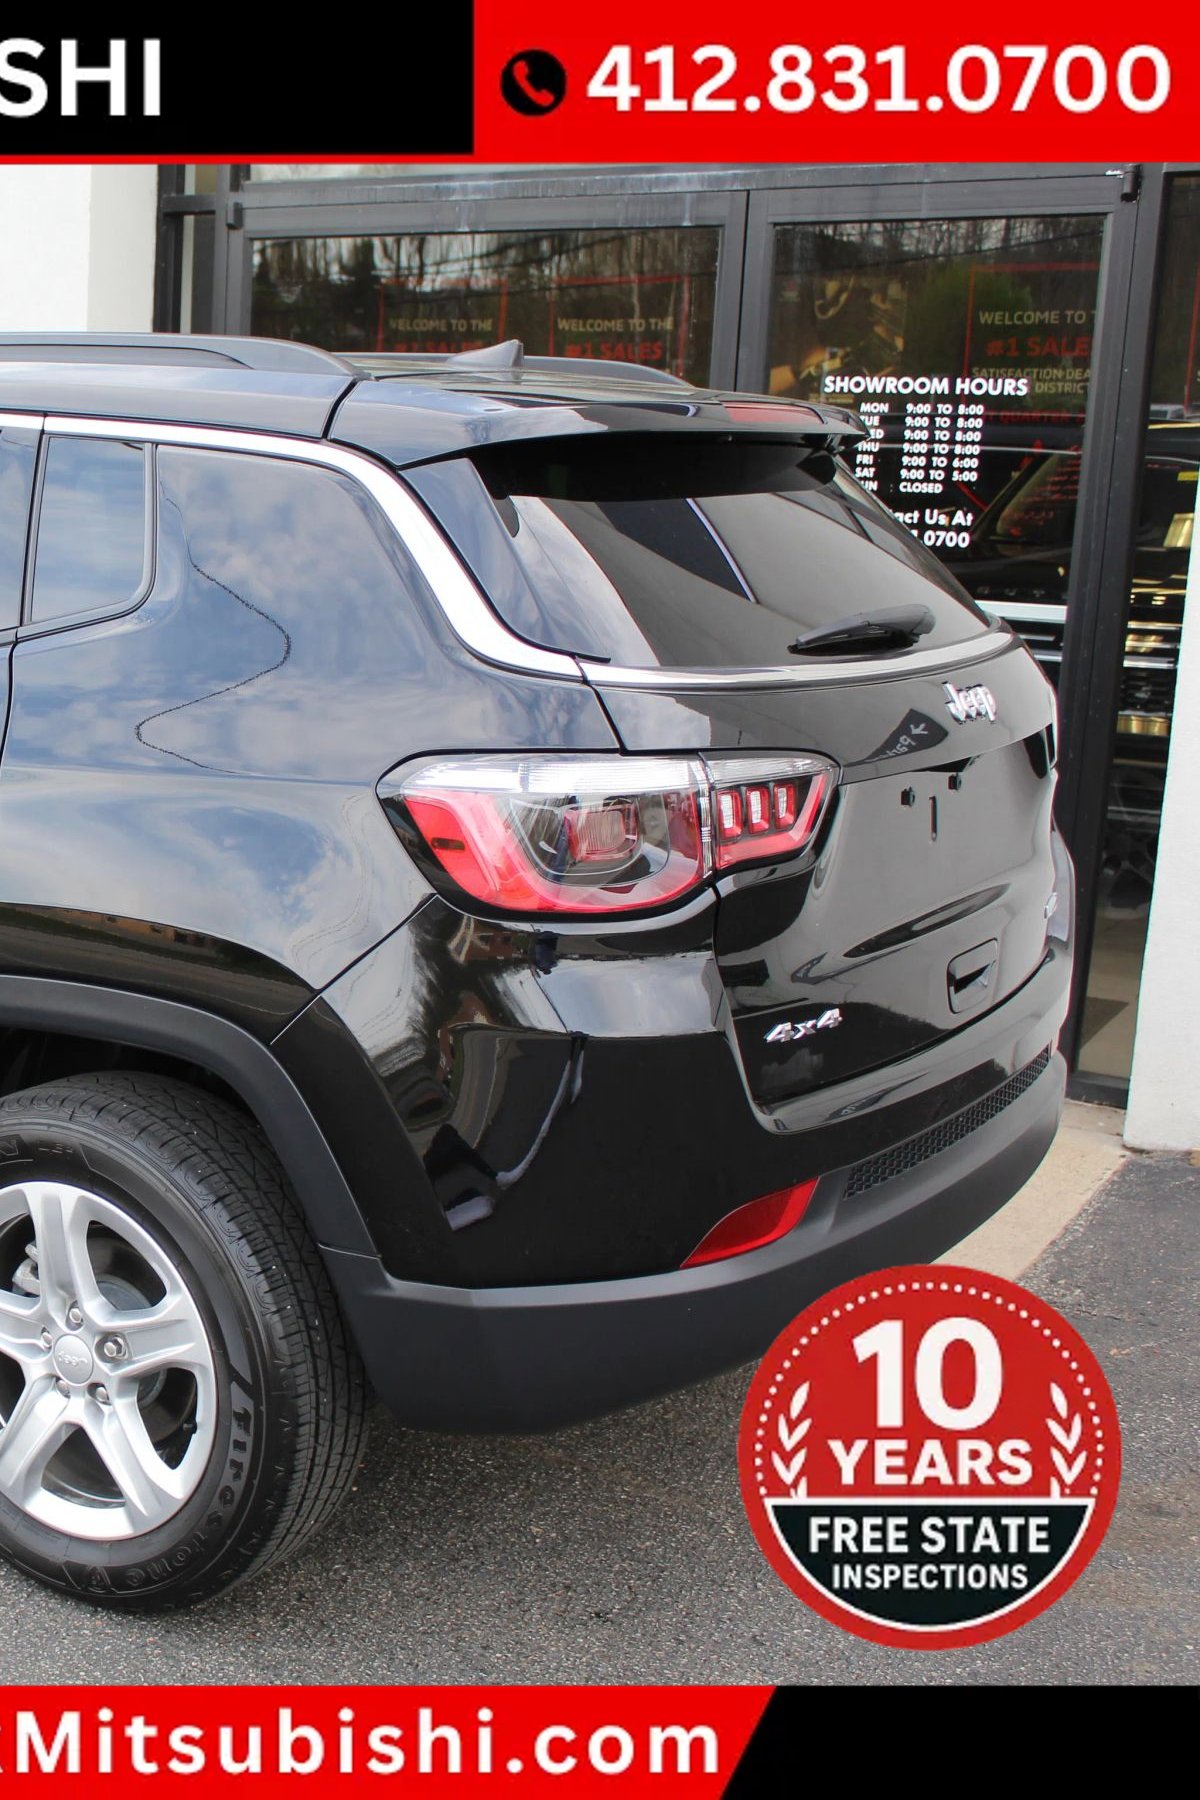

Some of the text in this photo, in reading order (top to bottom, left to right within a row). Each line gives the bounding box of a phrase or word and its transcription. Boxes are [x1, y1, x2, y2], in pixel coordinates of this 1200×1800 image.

[389, 318, 493, 332] WELCOME TO THE
[557, 317, 674, 332] WELCOME TO THE
[979, 311, 1060, 325] WELCOME
[1065, 310, 1087, 324] TO
[600, 341, 663, 361] SALES
[1027, 336, 1091, 357] SALE
[824, 376, 1028, 396] SHOWROOM HOURS
[860, 403, 984, 414] MON 9:00 TO 8:00
[905, 418, 929, 427] 9:00
[935, 418, 950, 427] TO
[957, 418, 983, 428] 8:00
[868, 430, 981, 441] ED 9:00 TO 8:00
[903, 444, 928, 453] 9:00
[933, 444, 949, 453] TO
[954, 445, 980, 455] 8:00
[856, 455, 978, 468] FRI 9:00 TO 6:00
[855, 468, 977, 481] SAT 9:00 TO 5:00
[899, 483, 942, 493] CLOSED
[924, 509, 946, 525] Us
[952, 511, 973, 526] At
[942, 681, 997, 724] Jeep
[763, 1007, 842, 1043] 4x4
[124, 1406, 253, 1590] Firestone
